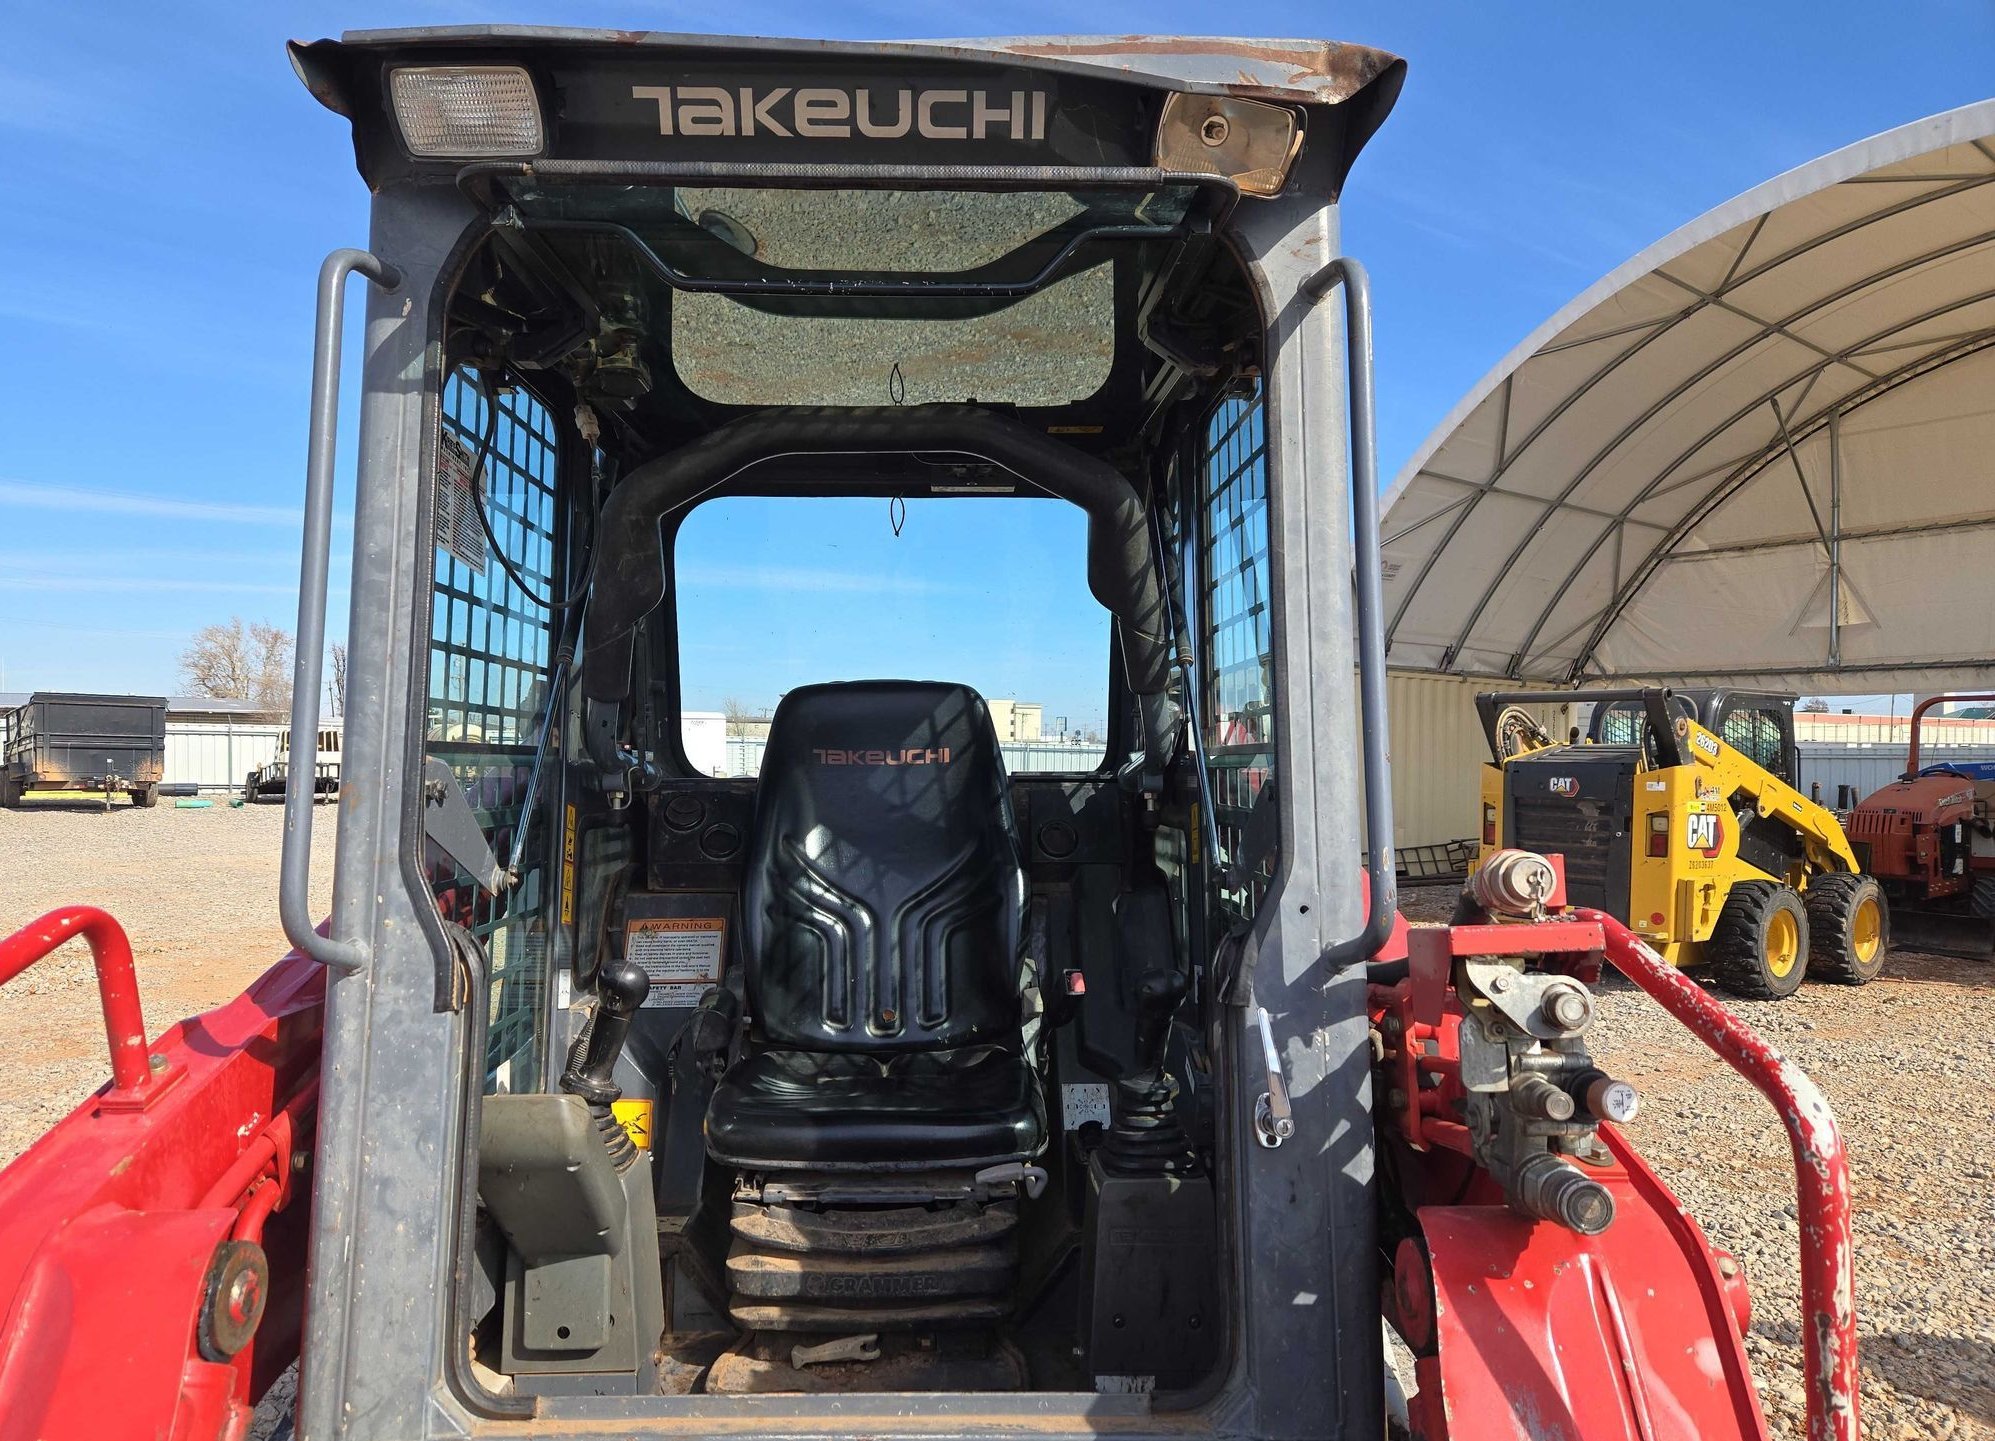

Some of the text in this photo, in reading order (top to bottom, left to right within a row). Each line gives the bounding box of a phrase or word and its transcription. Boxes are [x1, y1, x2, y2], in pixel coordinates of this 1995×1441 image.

[1549, 777, 1572, 792] CAT
[1687, 814, 1717, 849] CAT
[651, 922, 712, 930] WARNING
